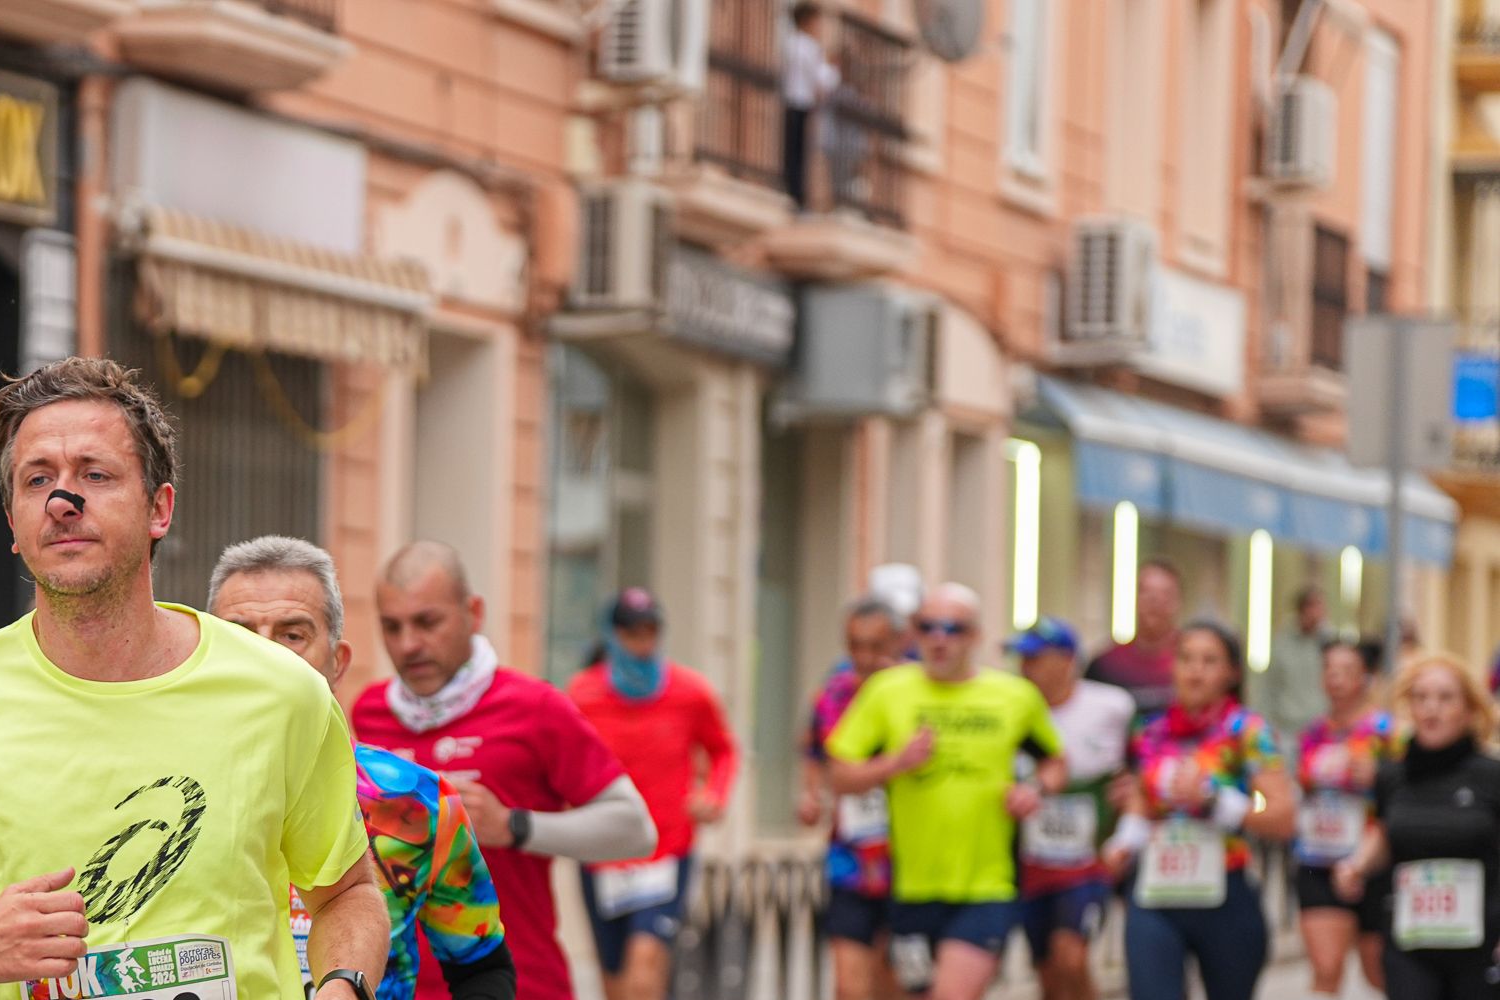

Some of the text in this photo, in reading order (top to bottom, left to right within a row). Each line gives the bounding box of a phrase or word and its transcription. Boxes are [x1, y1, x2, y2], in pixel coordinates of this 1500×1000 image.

[178, 947, 214, 958] carreras
[179, 952, 221, 966] populares
[151, 971, 176, 986] 2026
